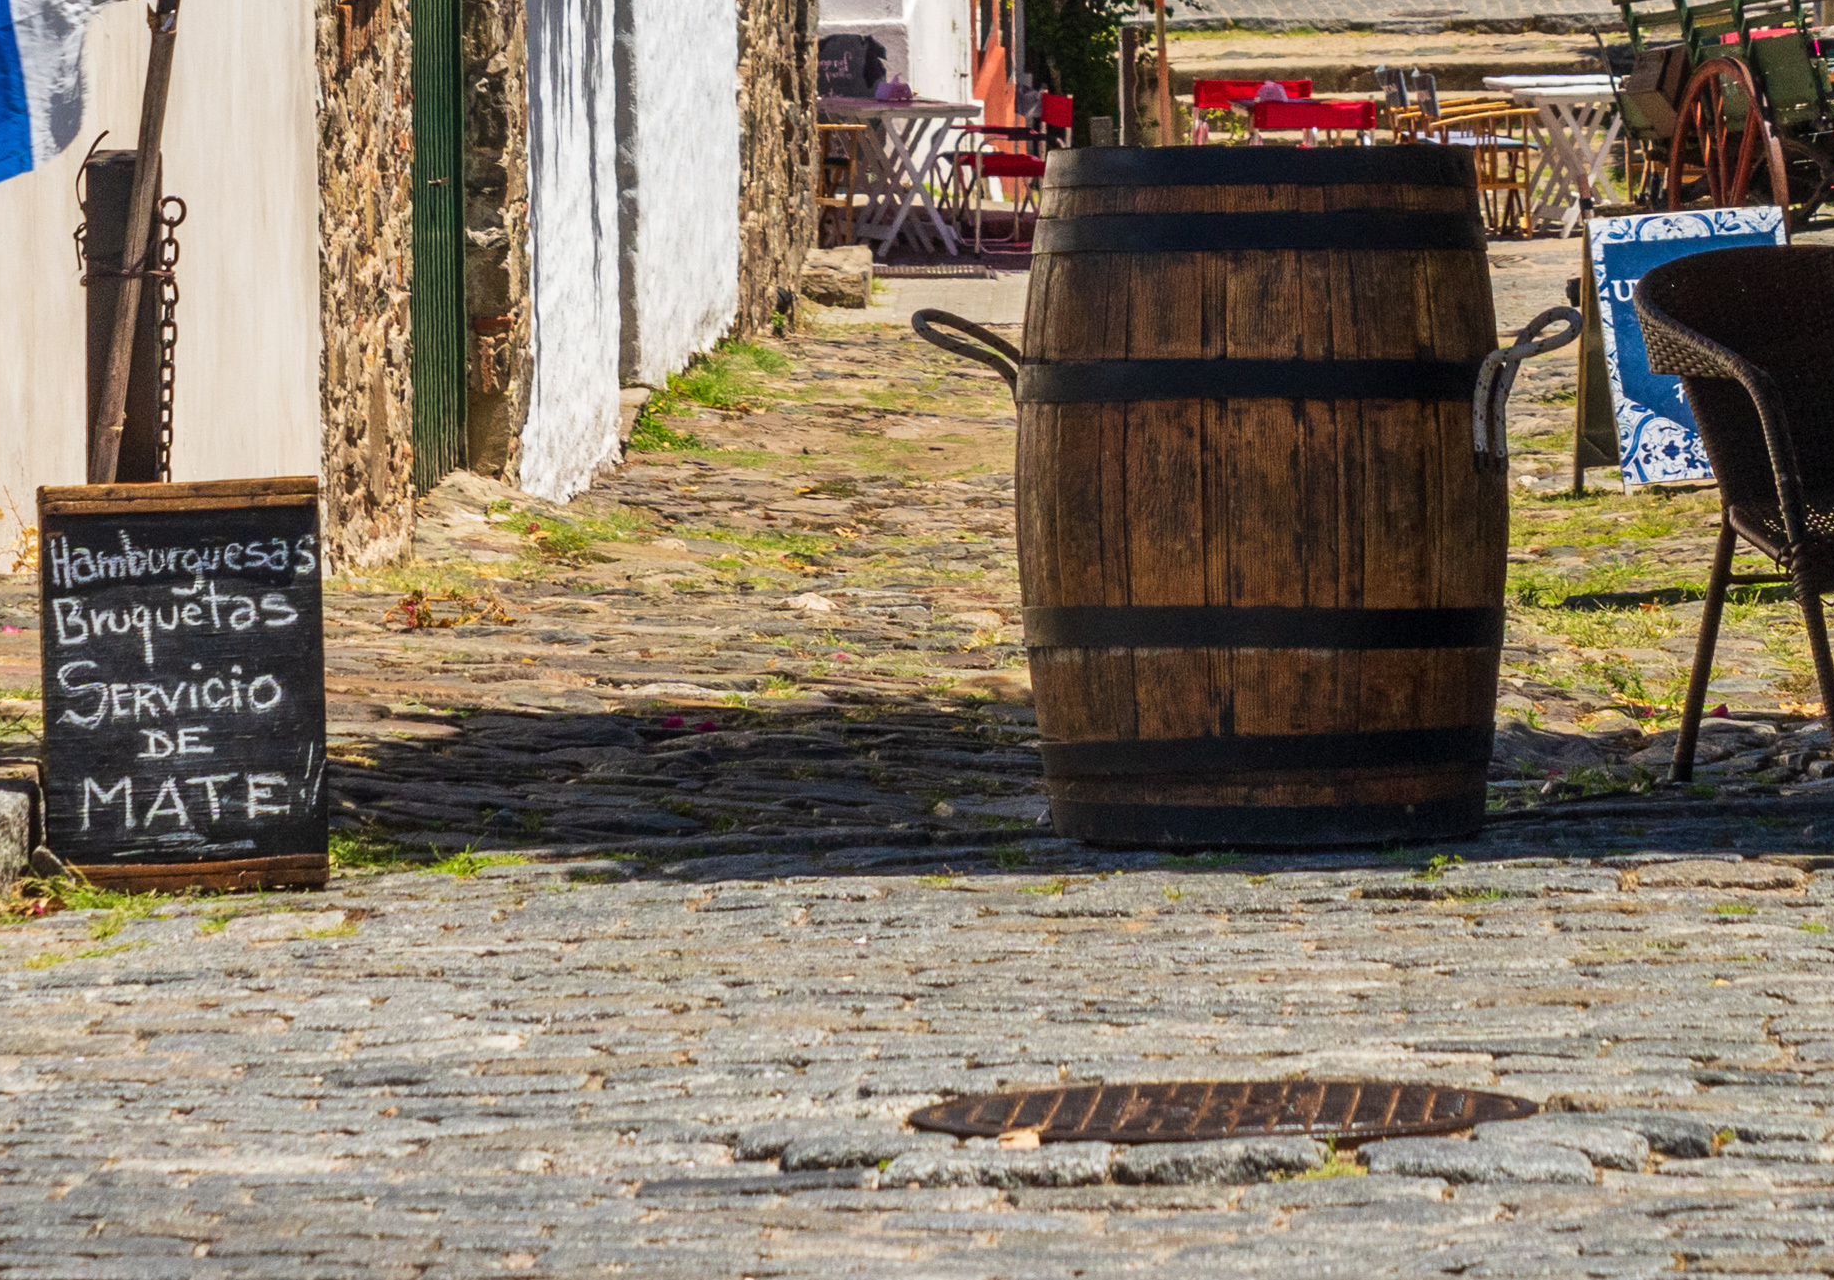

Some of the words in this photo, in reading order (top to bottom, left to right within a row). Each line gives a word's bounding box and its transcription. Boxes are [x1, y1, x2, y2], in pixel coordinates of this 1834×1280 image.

[51, 529, 316, 595] Hamburguesas
[52, 581, 299, 664] Bruquetas
[137, 727, 214, 759] DE
